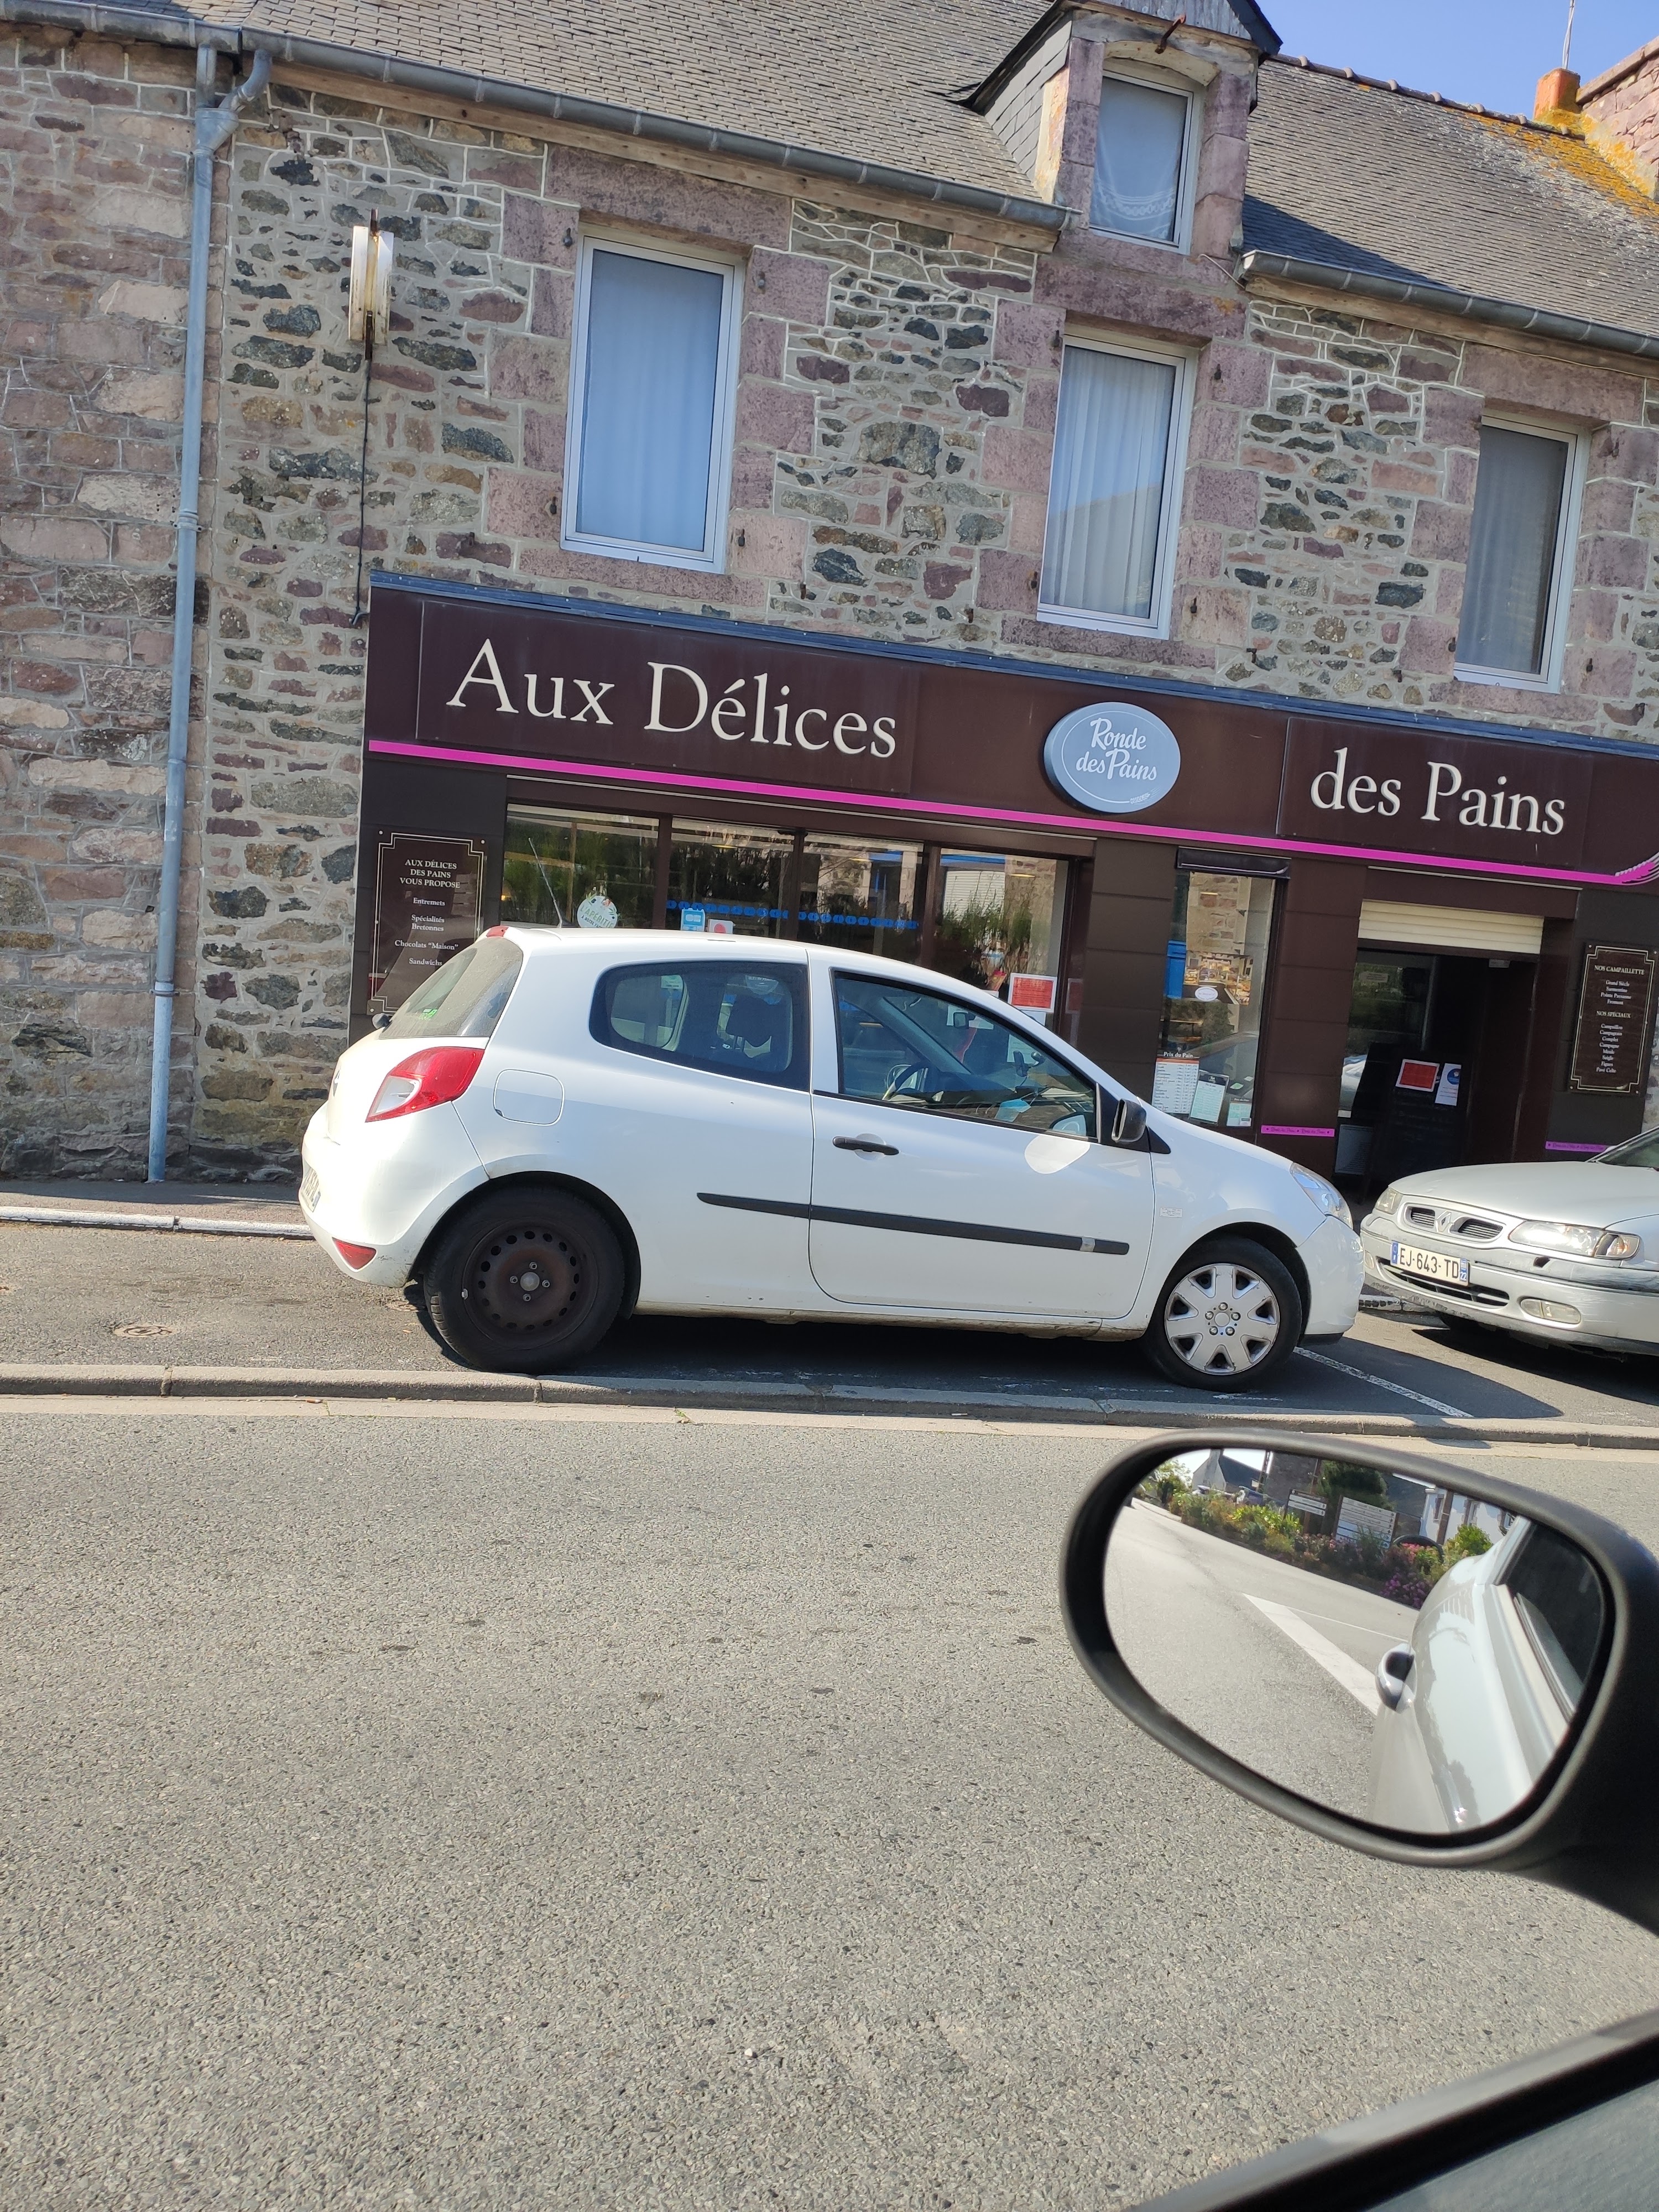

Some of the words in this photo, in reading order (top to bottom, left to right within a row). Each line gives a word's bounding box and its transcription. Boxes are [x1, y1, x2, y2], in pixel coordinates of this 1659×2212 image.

[446, 638, 615, 725] Aux
[643, 661, 896, 758] Délices
[1090, 717, 1147, 750] Ronde
[1076, 751, 1105, 774] des
[1105, 748, 1157, 780] Pains
[1310, 747, 1401, 816] des
[1420, 761, 1565, 835] Pains
[405, 859, 423, 867] AUX
[425, 859, 457, 870] DÉLICES
[427, 870, 451, 879] PAINS
[399, 877, 422, 885] VOUS
[424, 879, 461, 889] PROPOSE
[413, 897, 446, 906] Entremets
[411, 914, 445, 923] Spécialités
[411, 923, 444, 932] Bretonnes
[394, 940, 427, 948] Chocolats
[409, 957, 442, 966] Sandwichs
[1606, 966, 1645, 975] CAMPAILLETTE
[1400, 1248, 1459, 1279] EJ-643-TD
[1460, 1271, 1467, 1281] 22
